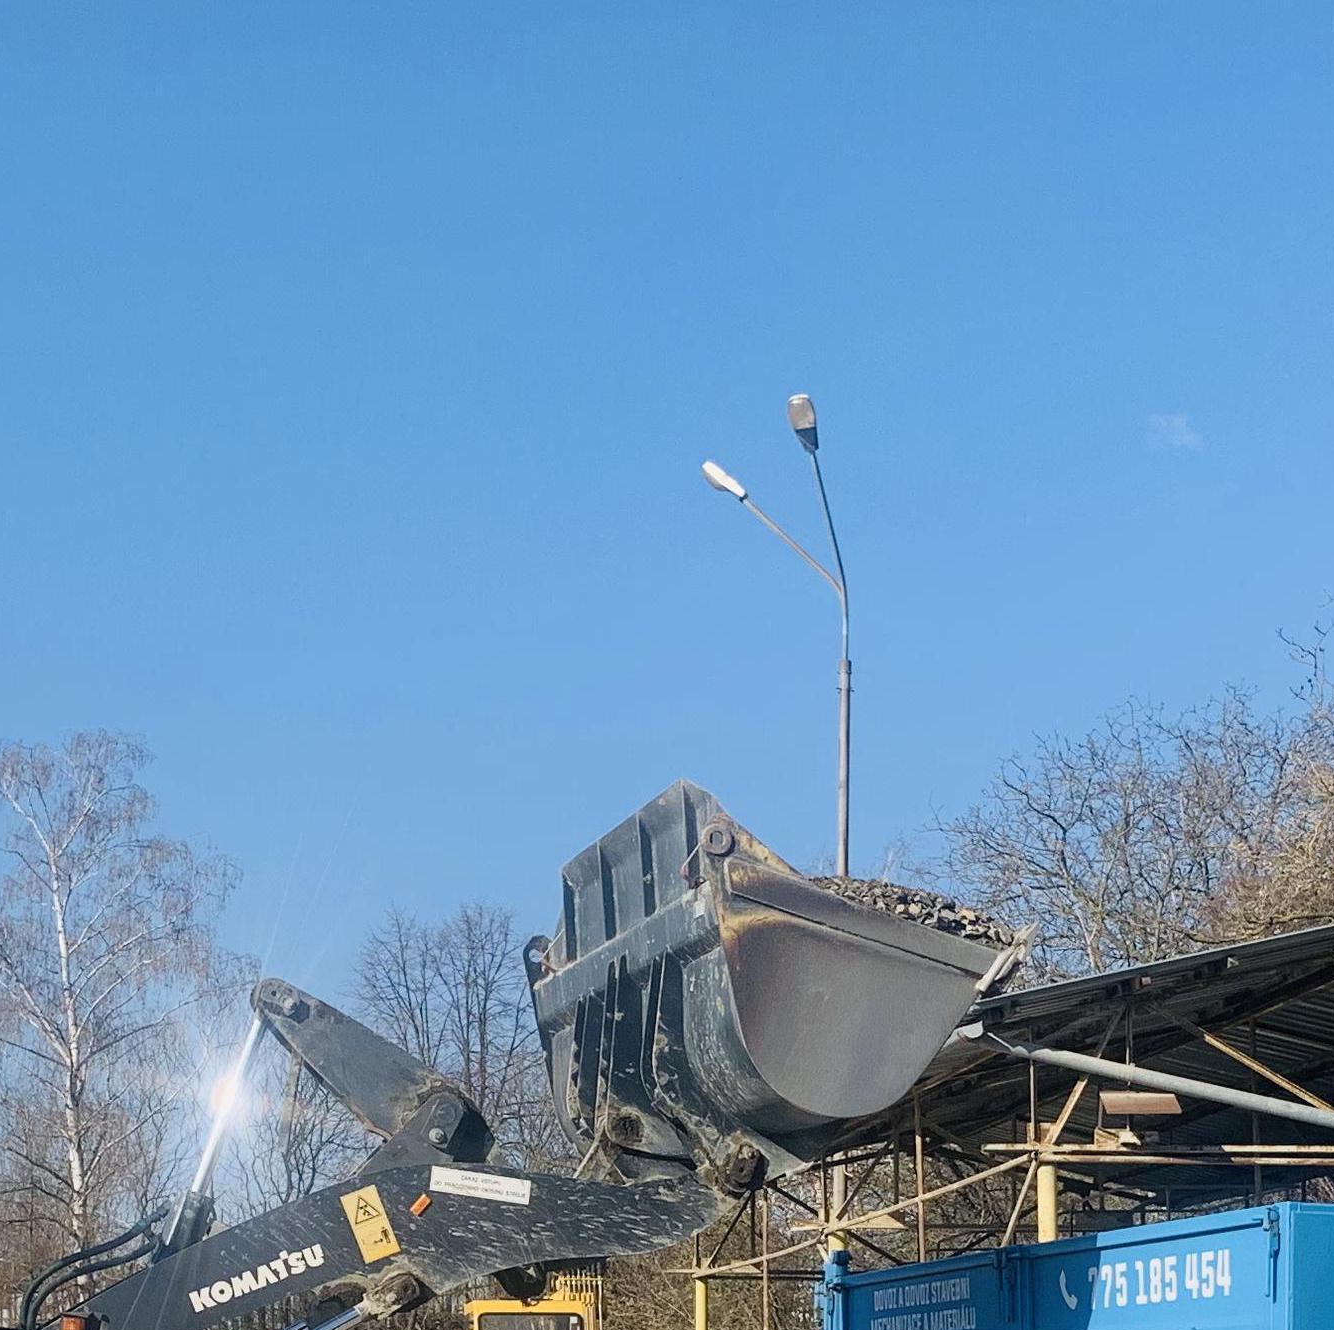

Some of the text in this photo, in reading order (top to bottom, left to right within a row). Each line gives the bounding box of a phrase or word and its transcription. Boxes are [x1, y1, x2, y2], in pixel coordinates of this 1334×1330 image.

[188, 1243, 325, 1314] KOMATSU
[873, 1287, 898, 1313] DOVOZ
[898, 1286, 905, 1308] A
[1087, 1248, 1232, 1311] 775 185 454
